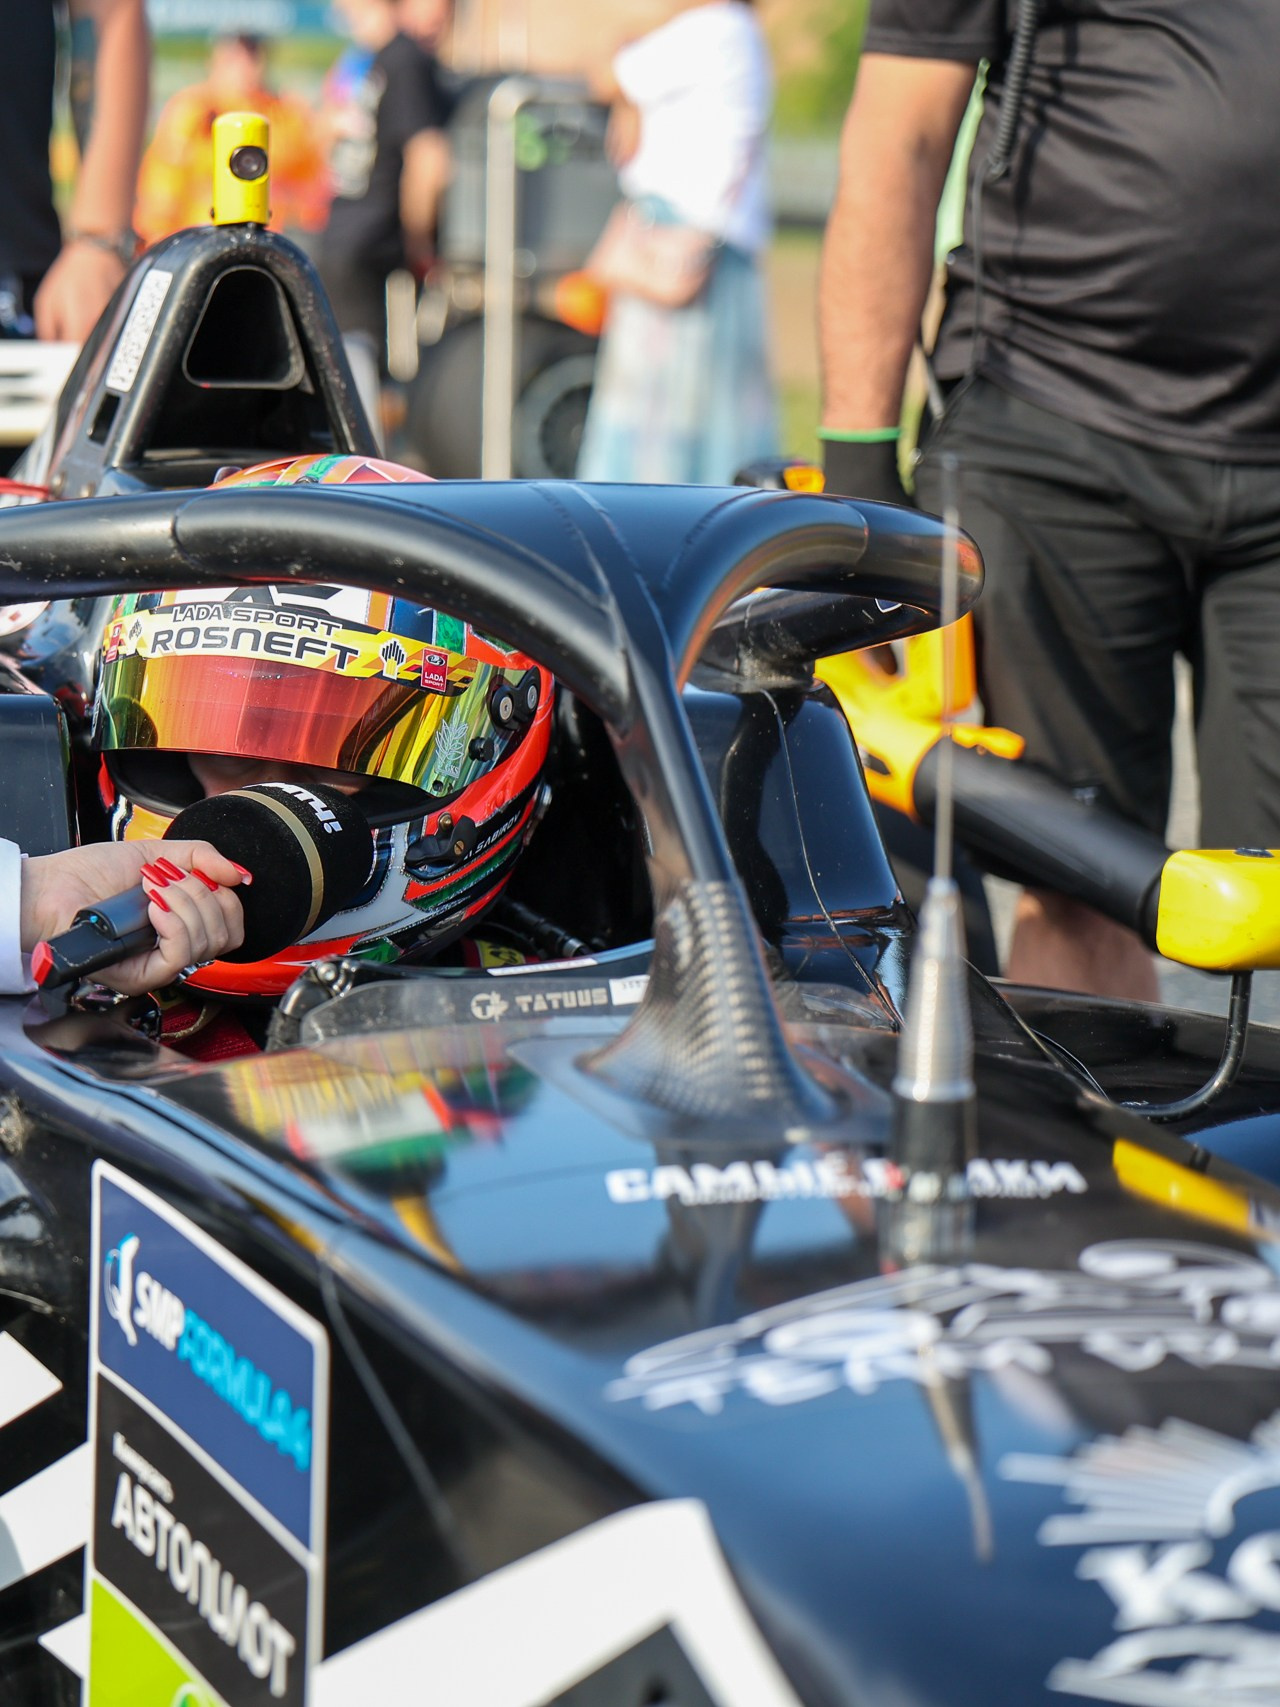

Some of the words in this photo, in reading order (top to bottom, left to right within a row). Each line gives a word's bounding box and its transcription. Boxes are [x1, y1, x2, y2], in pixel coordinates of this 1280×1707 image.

[172, 605, 223, 623] LADA
[232, 608, 342, 637] SPORT
[151, 626, 359, 670] ROSNEFT
[424, 672, 444, 682] LADA
[515, 987, 609, 1013] TATUUS
